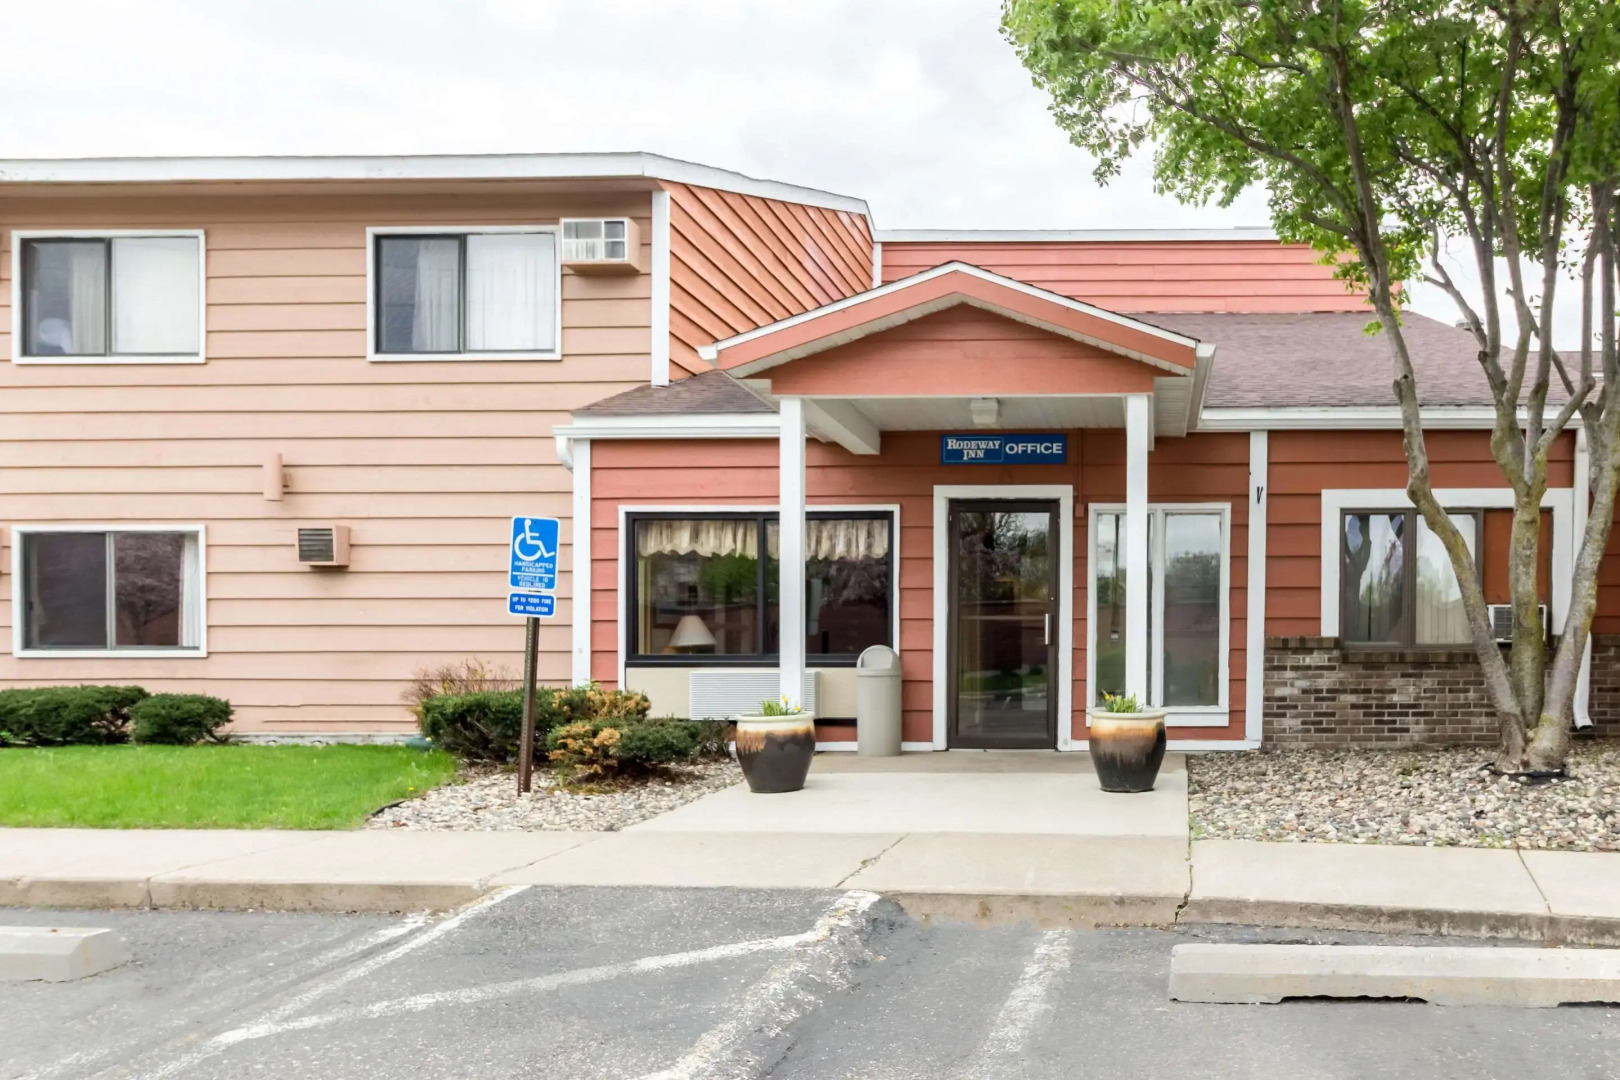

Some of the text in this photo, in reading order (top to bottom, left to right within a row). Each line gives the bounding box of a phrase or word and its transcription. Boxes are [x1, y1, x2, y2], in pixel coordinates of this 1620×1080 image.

[947, 439, 1001, 450] RODEWAY
[1005, 443, 1063, 454] OFFICE
[963, 450, 985, 460] INN
[514, 561, 554, 569] HANDICAPPED
